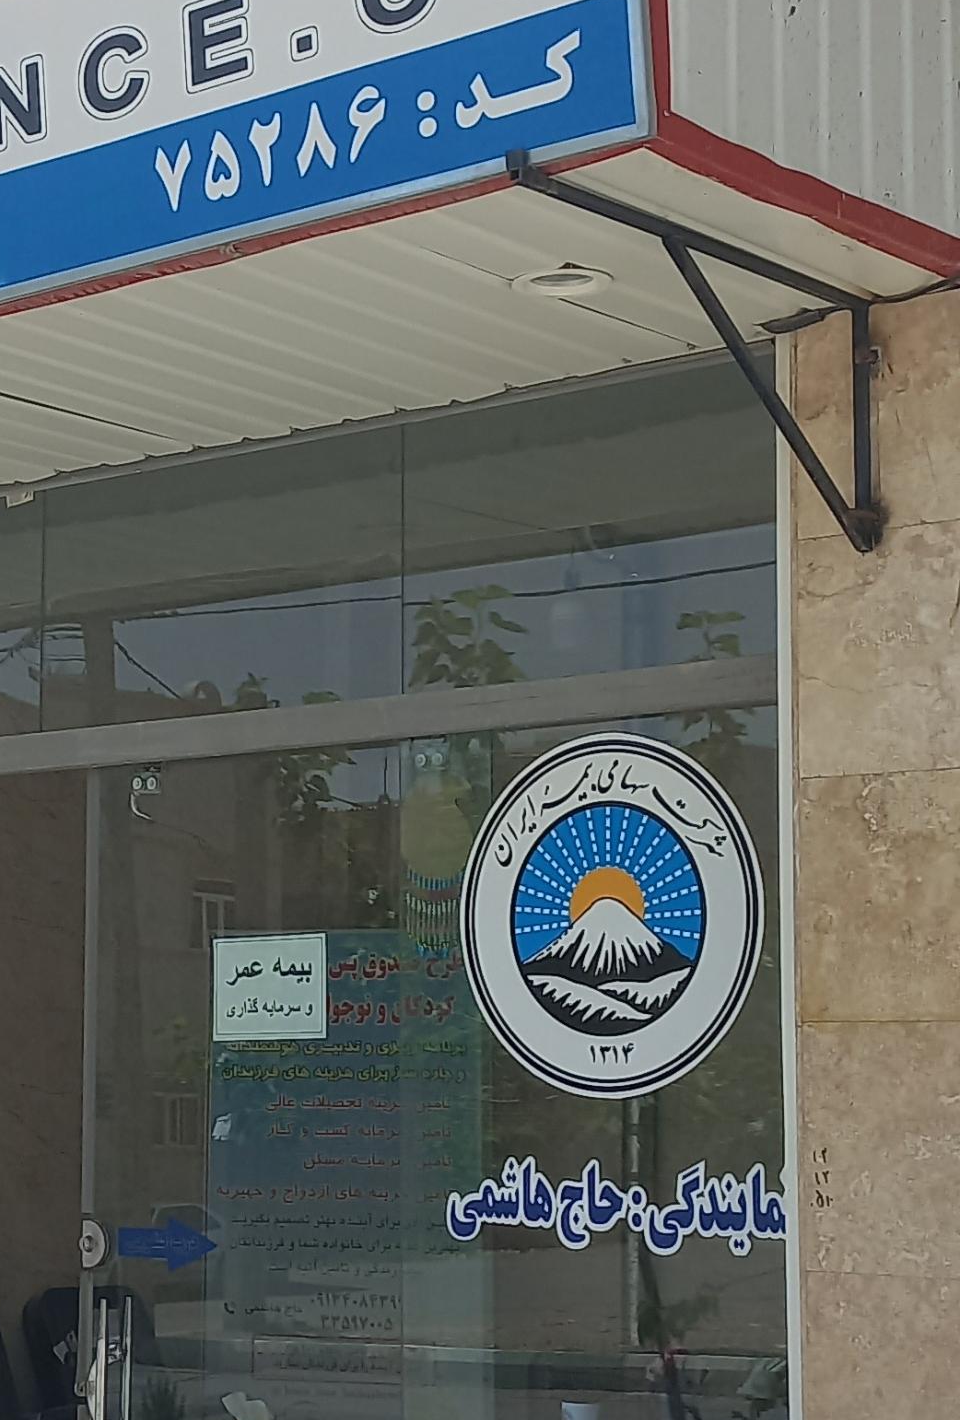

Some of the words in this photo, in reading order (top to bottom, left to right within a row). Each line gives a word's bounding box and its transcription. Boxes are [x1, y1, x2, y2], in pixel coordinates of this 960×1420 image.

[154, 84, 387, 213] ۷۵۲۸۶
[494, 794, 537, 868] ایران
[226, 959, 264, 986] عمر
[271, 956, 314, 983] بیمه
[225, 996, 260, 1019] گذاری
[262, 1000, 302, 1017] سرمایه
[303, 1002, 314, 1016] و
[587, 1042, 635, 1066] ۱۳۱۴
[446, 1155, 556, 1242] هاشمی
[556, 1158, 627, 1250] حاج
